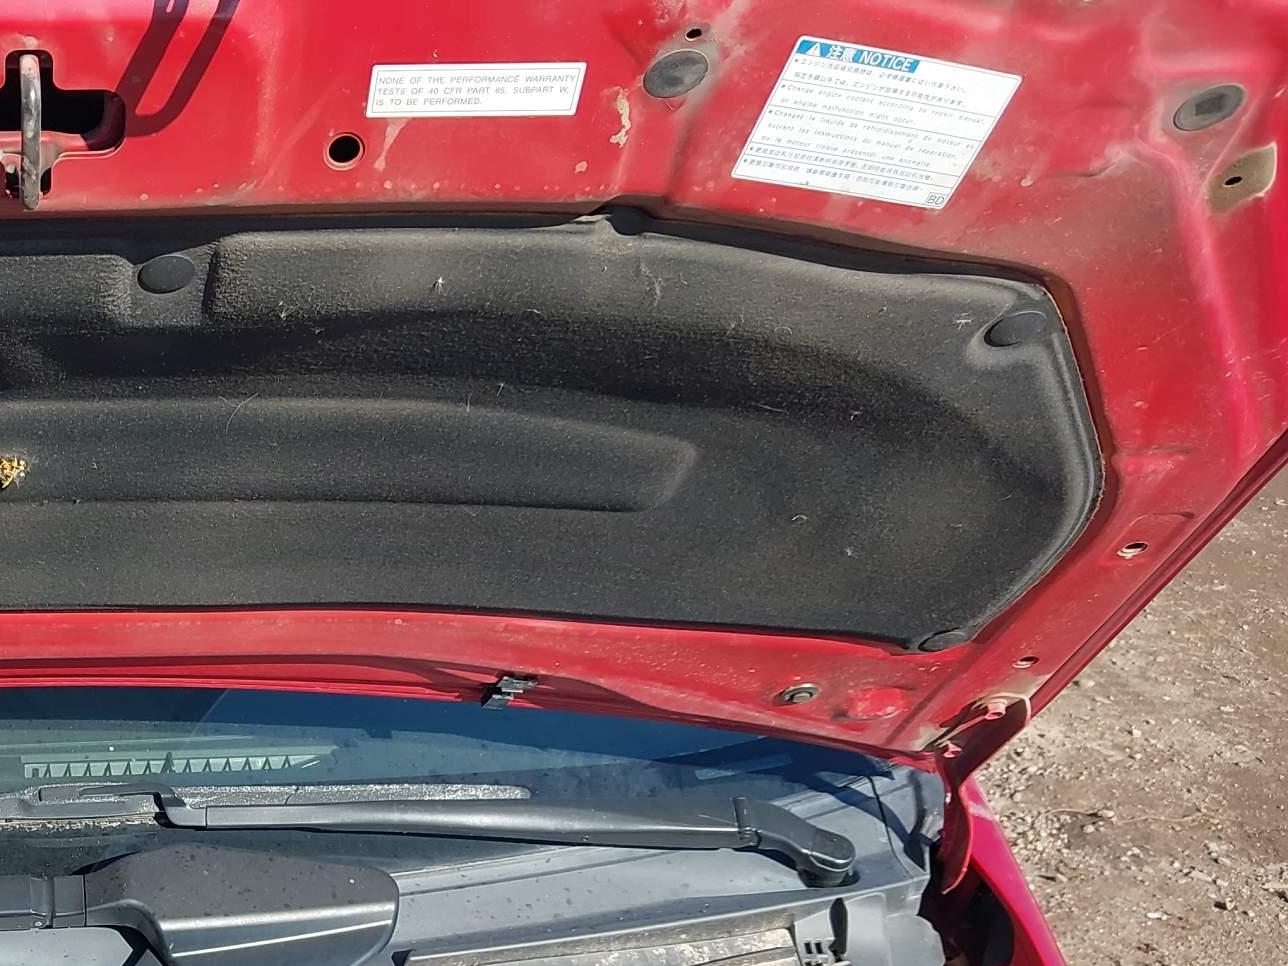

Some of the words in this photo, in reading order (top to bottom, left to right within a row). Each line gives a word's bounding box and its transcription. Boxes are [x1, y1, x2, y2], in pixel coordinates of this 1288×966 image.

[824, 43, 858, 62] 注意
[856, 49, 916, 72] NOTICE
[377, 76, 405, 85] NONE
[408, 76, 422, 84] OF
[426, 75, 445, 84] THE
[449, 74, 520, 84] PERFORMANCE
[524, 74, 577, 83] WARRANTY
[376, 87, 406, 96] TESTS
[409, 86, 424, 95] OF
[427, 86, 439, 95] 40
[442, 86, 462, 95] CFR
[466, 85, 491, 94] PART
[511, 85, 554, 94] SUBPART
[785, 83, 815, 94] Change
[816, 89, 843, 100] engine
[375, 97, 385, 106] IS
[389, 97, 402, 106] TO
[405, 97, 418, 106] BE
[422, 96, 484, 106] PERFORMED.
[791, 98, 819, 109] engine
[820, 102, 867, 117] malfunction
